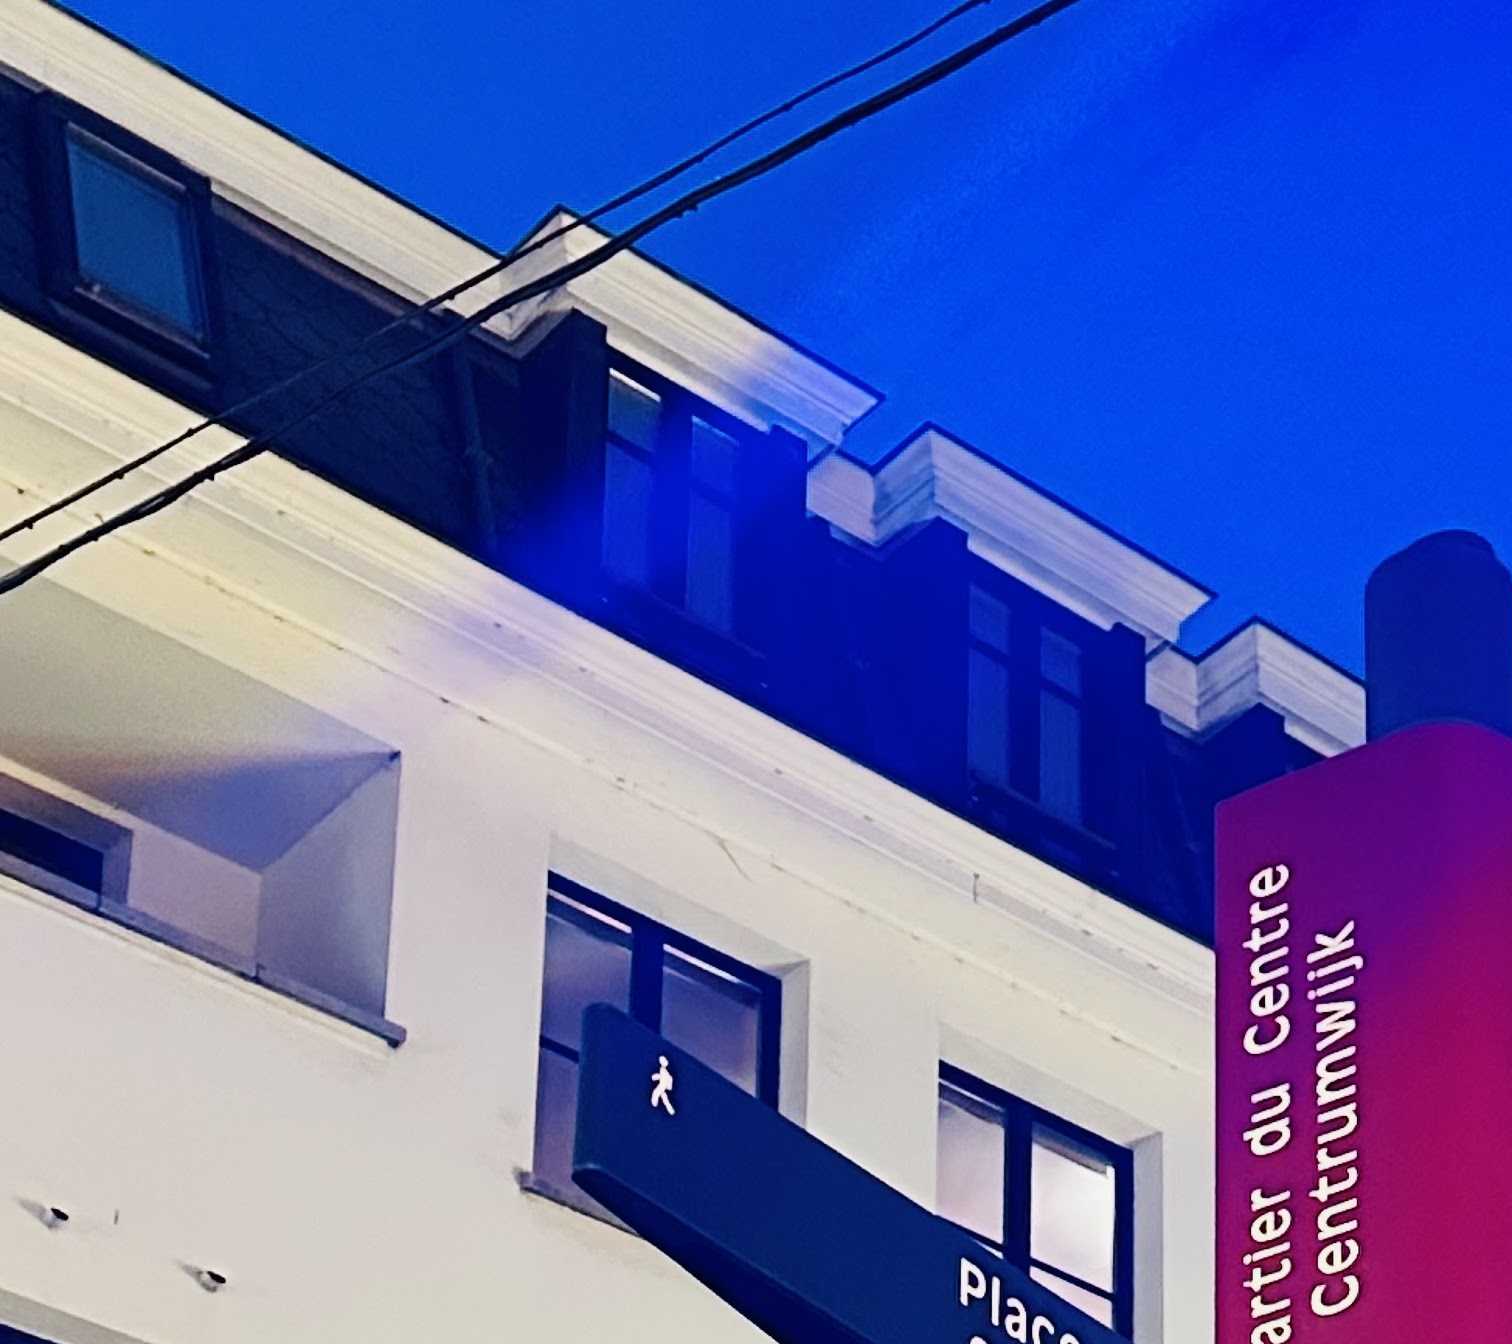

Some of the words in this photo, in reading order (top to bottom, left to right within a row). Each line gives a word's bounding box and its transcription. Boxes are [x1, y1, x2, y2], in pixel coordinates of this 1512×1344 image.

[1242, 863, 1290, 1055] Centre
[1243, 1081, 1291, 1156] du
[1307, 920, 1364, 1317] Centrumwijk
